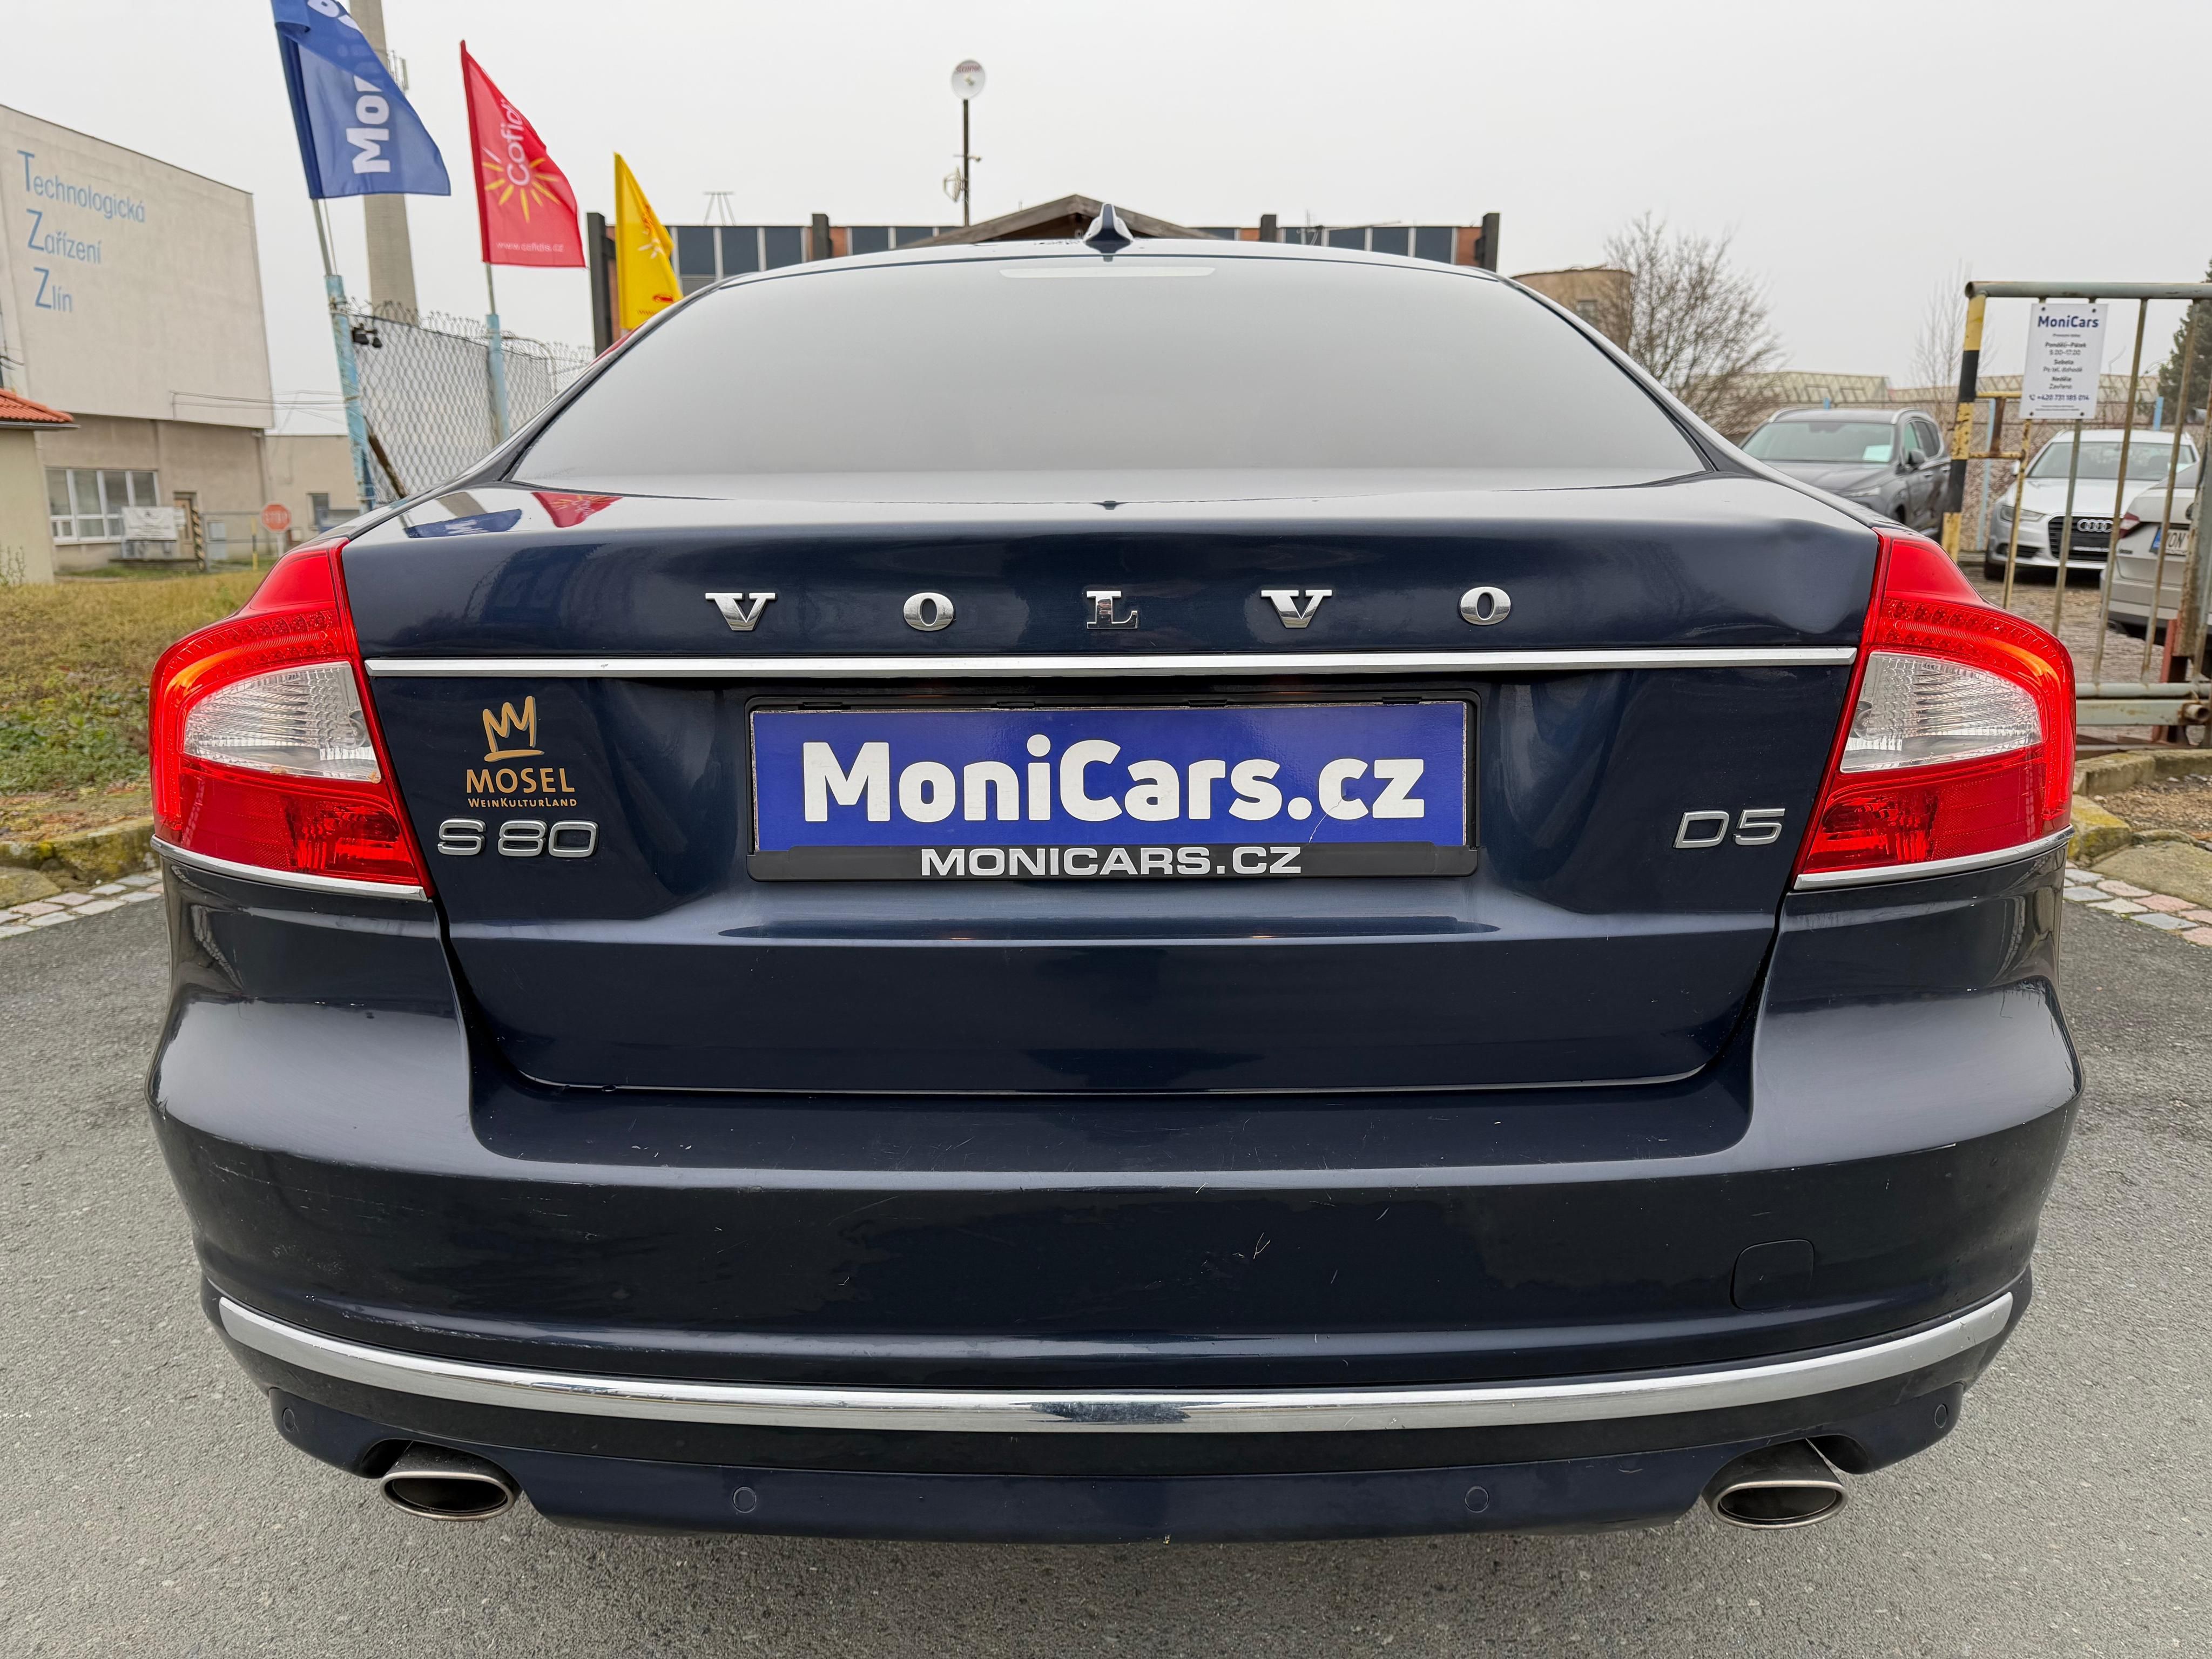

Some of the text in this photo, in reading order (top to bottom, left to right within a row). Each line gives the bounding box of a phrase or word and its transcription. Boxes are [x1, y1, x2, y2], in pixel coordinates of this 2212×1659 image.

[17, 150, 146, 223] Technologická
[26, 208, 102, 265] Zařízení
[33, 267, 73, 313] Zlín
[2038, 315, 2099, 328] MoniCars
[705, 586, 1512, 632] VOLVO
[466, 768, 575, 793] MOSEL
[802, 734, 1425, 822] MoniCars.cz
[1673, 808, 1785, 848] D5
[920, 846, 1302, 876] MONICARS.CZ
